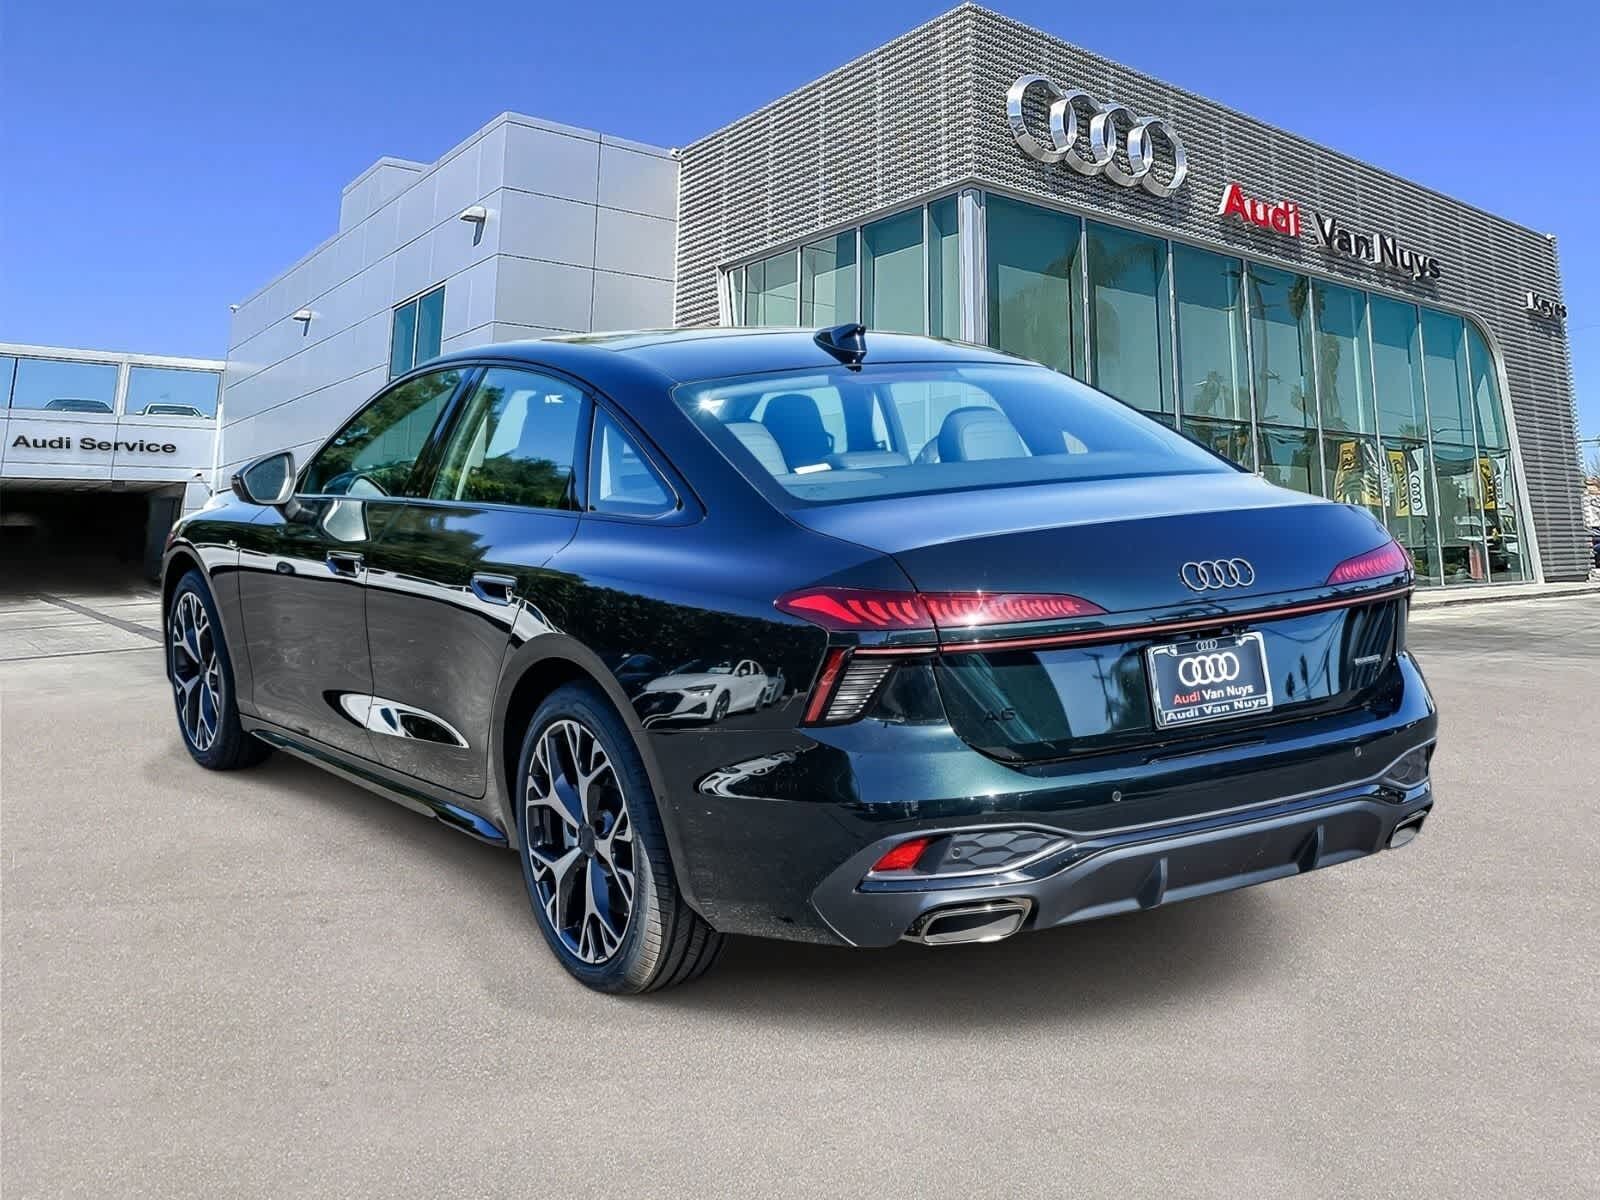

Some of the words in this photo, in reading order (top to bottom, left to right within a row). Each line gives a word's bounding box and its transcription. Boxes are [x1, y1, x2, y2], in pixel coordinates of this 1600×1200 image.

[1219, 183, 1302, 236] Audi
[1311, 212, 1370, 259] Van
[1373, 233, 1442, 281] Nuys
[12, 435, 71, 449] Audi
[79, 437, 177, 454] Service
[1174, 690, 1200, 705] Audi
[1202, 688, 1225, 701] Van
[1226, 684, 1254, 697] Nuys
[1166, 707, 1199, 721] Audi
[1203, 703, 1230, 715] Van
[1234, 697, 1267, 710] Nuys
